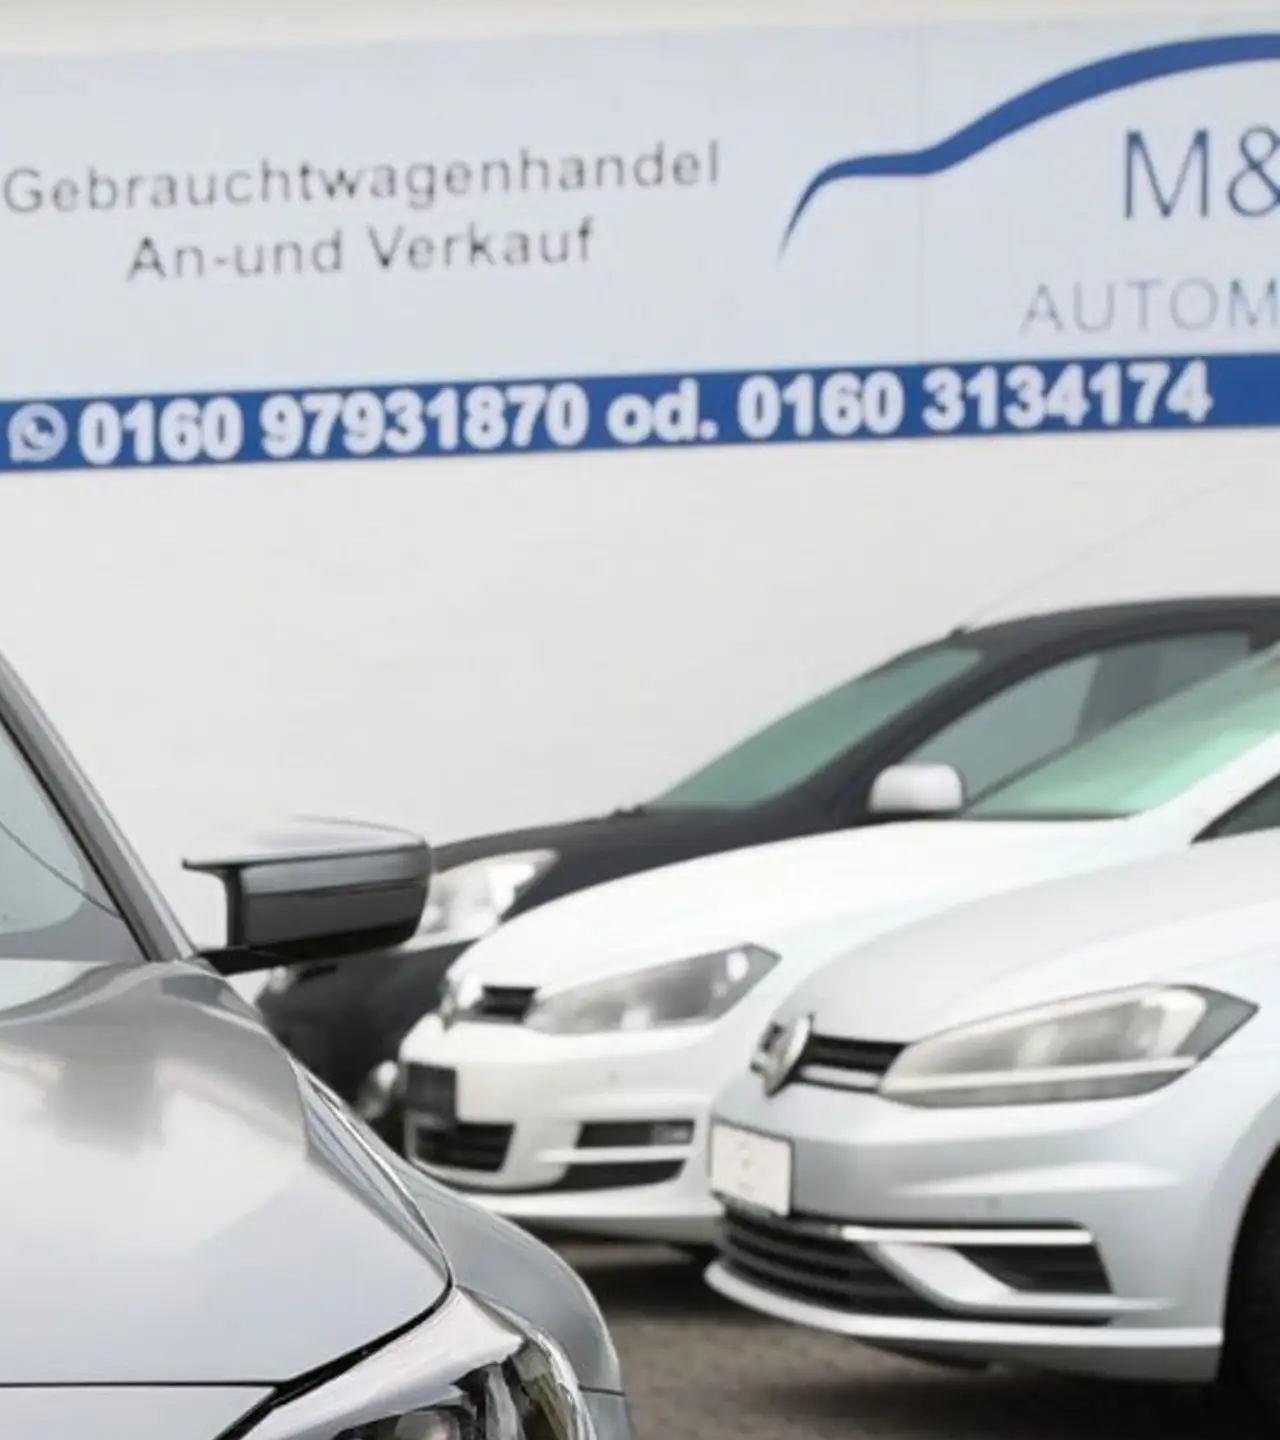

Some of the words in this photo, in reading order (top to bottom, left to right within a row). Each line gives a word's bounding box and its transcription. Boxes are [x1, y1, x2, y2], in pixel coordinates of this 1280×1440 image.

[2, 141, 721, 215] Gebrauchtwagenhandel
[128, 230, 343, 281] An-und
[367, 216, 596, 270] Verkauf
[78, 399, 243, 465] 0160
[259, 383, 589, 458] 97931870
[606, 378, 718, 443] od.
[738, 371, 904, 439] 0160
[922, 359, 1214, 432] 3134174
